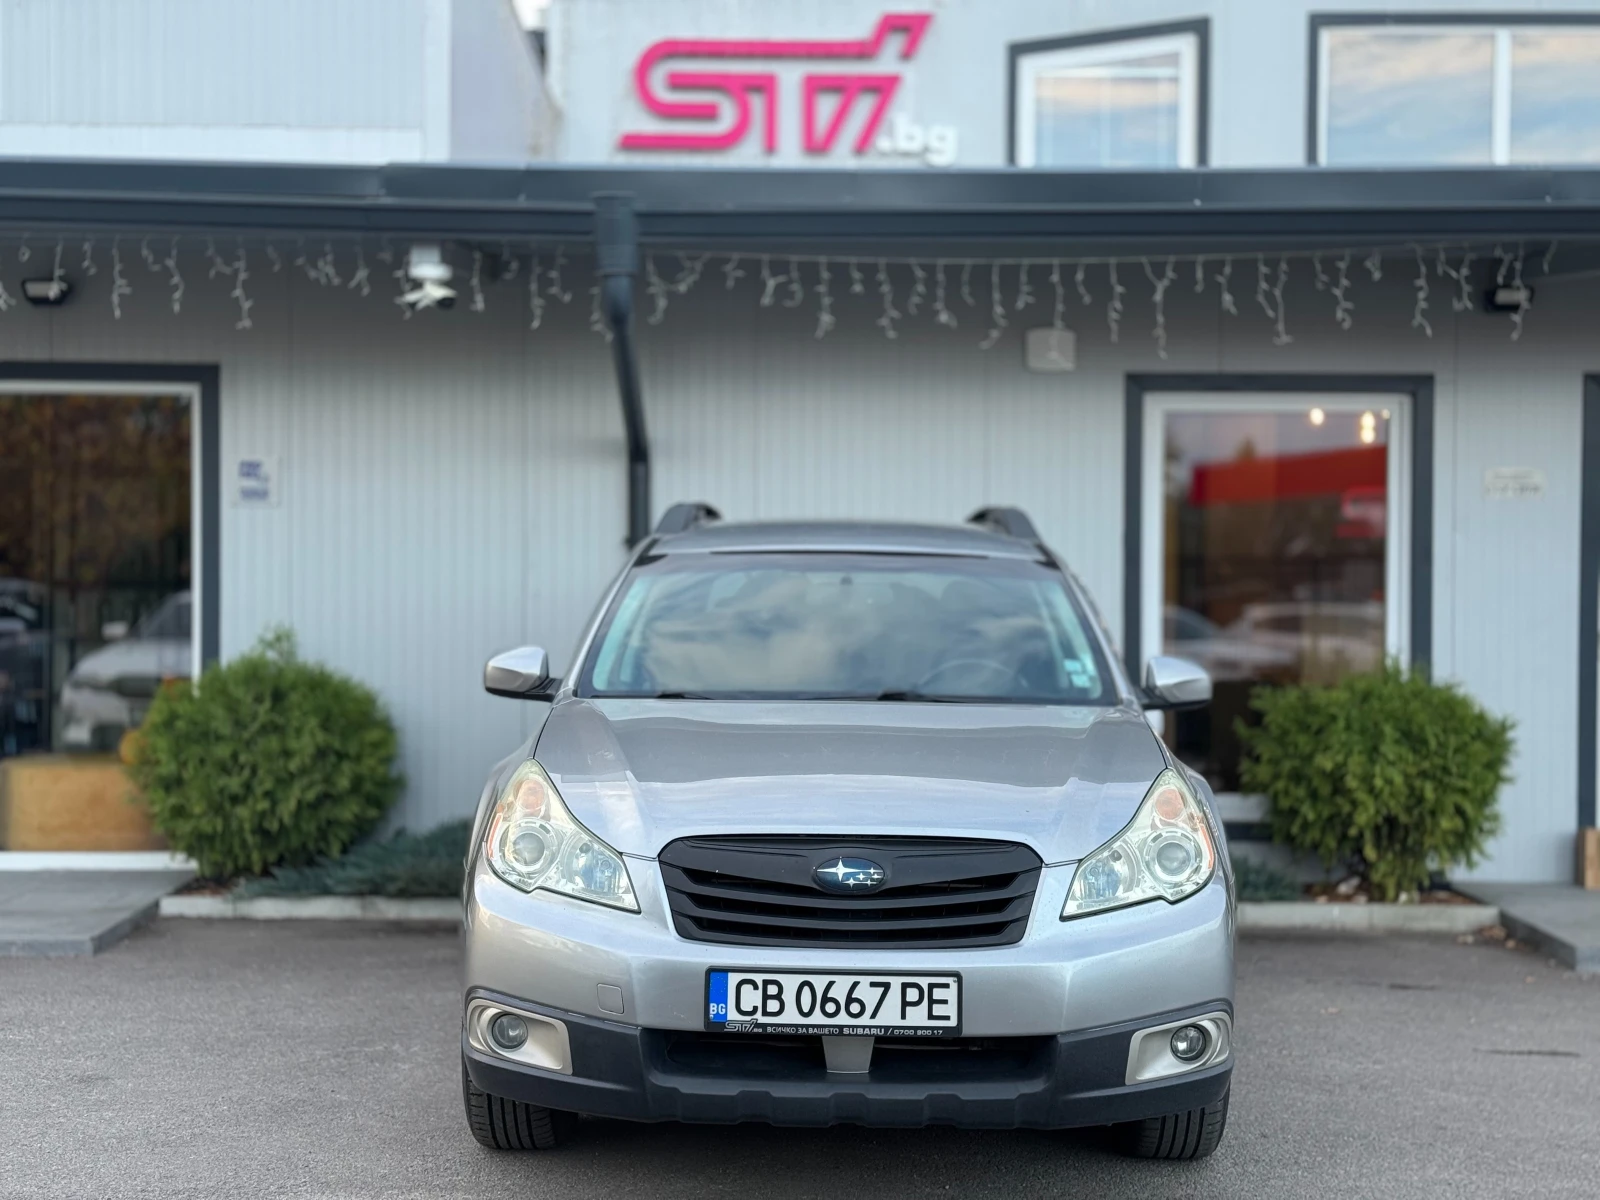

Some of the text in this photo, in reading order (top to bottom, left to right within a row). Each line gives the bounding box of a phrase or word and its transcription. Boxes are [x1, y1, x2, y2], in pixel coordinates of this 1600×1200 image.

[734, 978, 951, 1021] CB 0667 PE
[709, 1003, 726, 1015] BG
[797, 1026, 808, 1034] ЗА
[808, 1027, 839, 1035] ВАШЕТО
[843, 1027, 885, 1036] SUBARU
